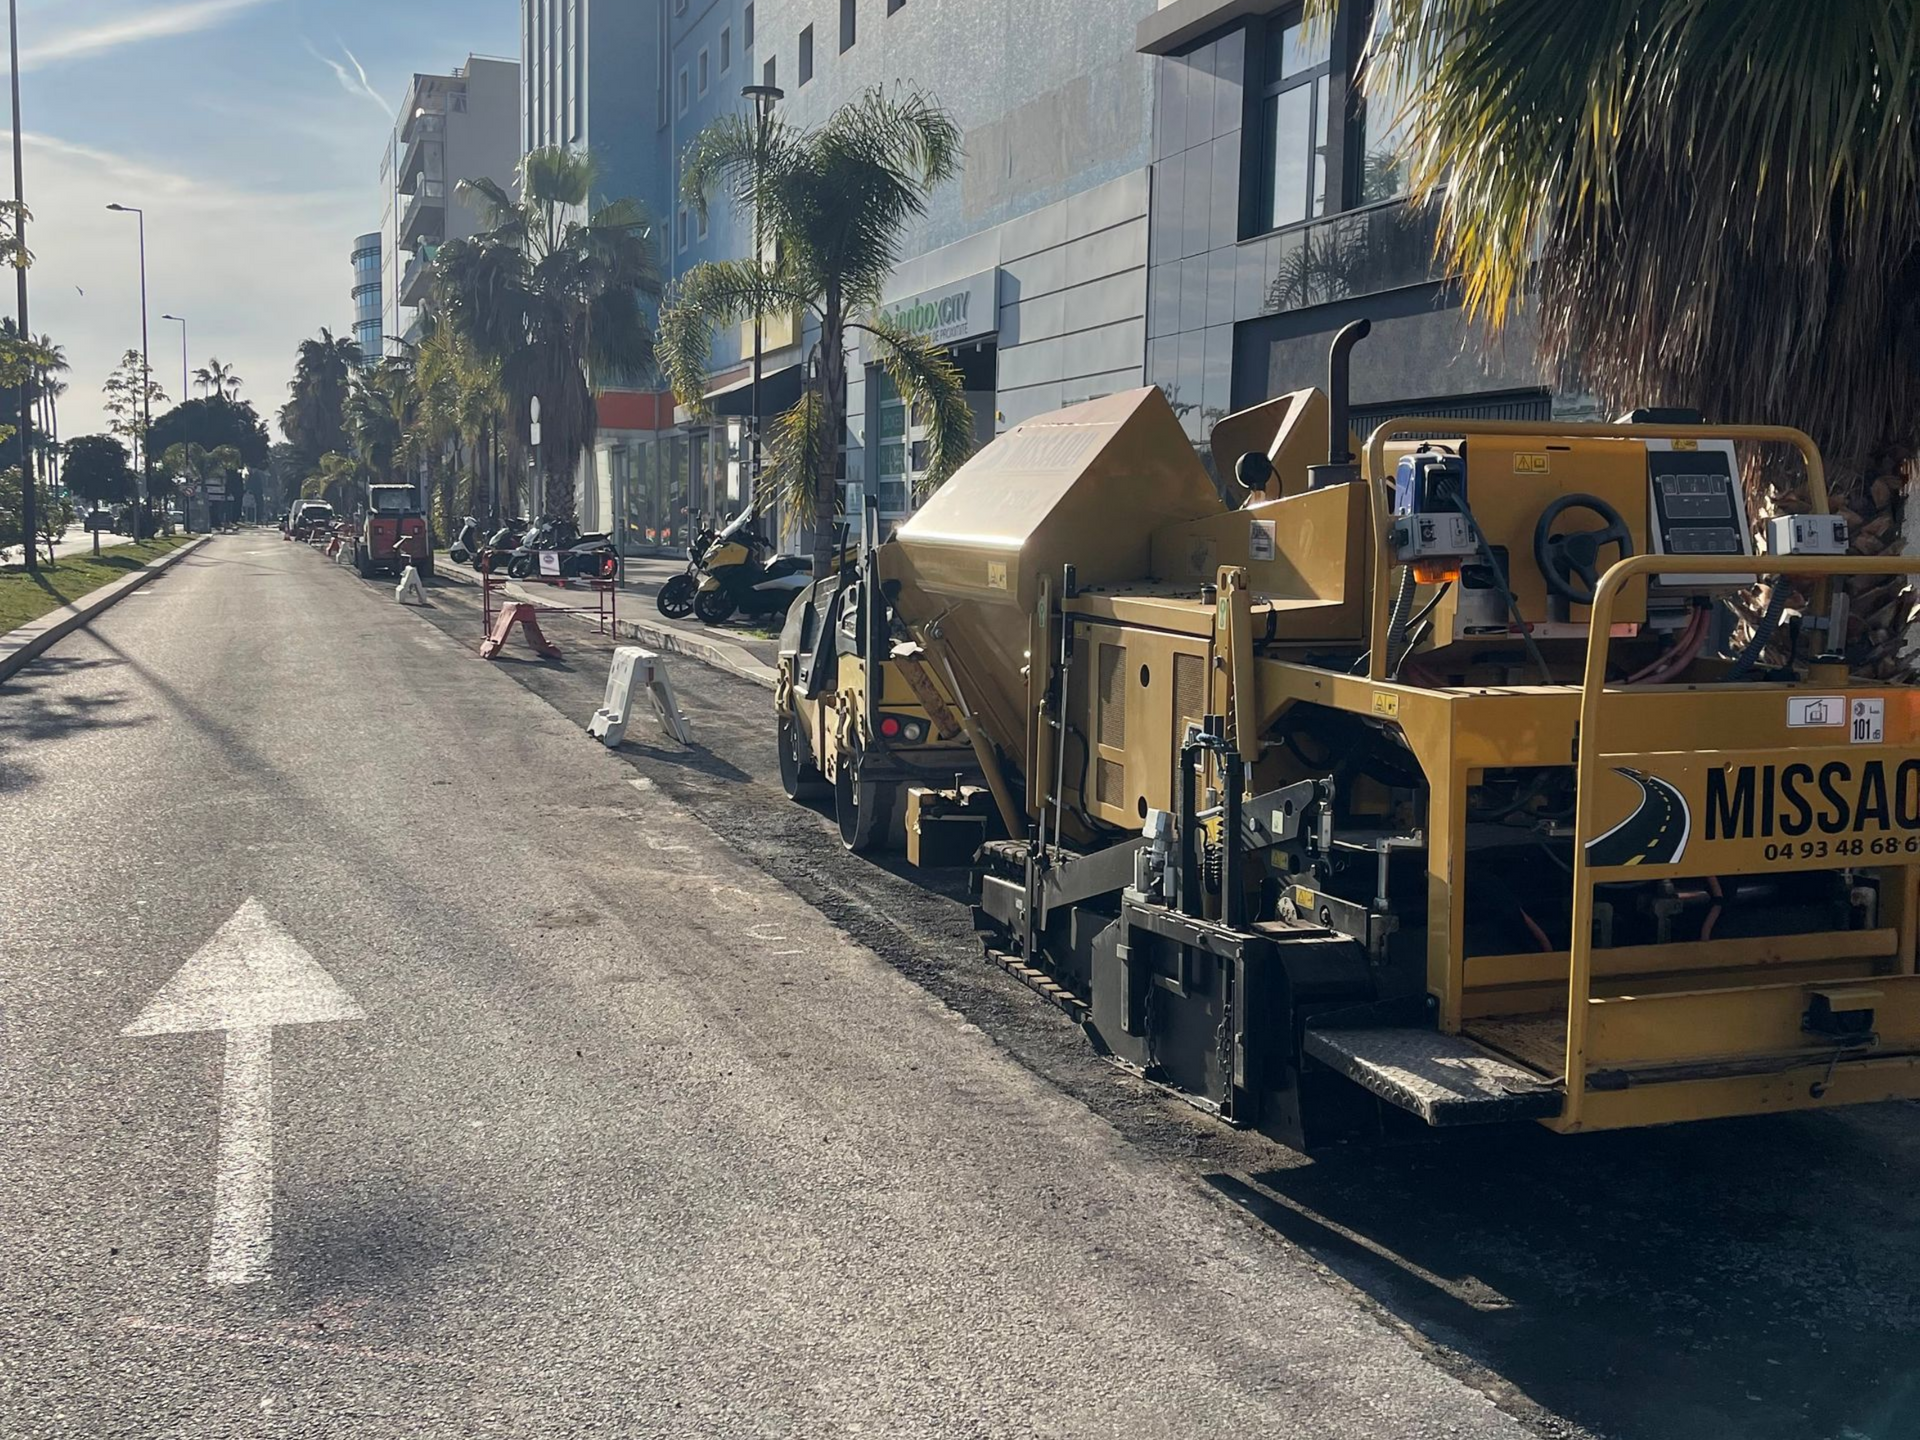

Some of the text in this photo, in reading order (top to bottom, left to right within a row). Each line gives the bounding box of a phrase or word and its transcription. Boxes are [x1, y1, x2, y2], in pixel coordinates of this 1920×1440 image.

[1853, 718, 1871, 740] 101
[1763, 836, 1920, 861] 04 93 48 68 6
